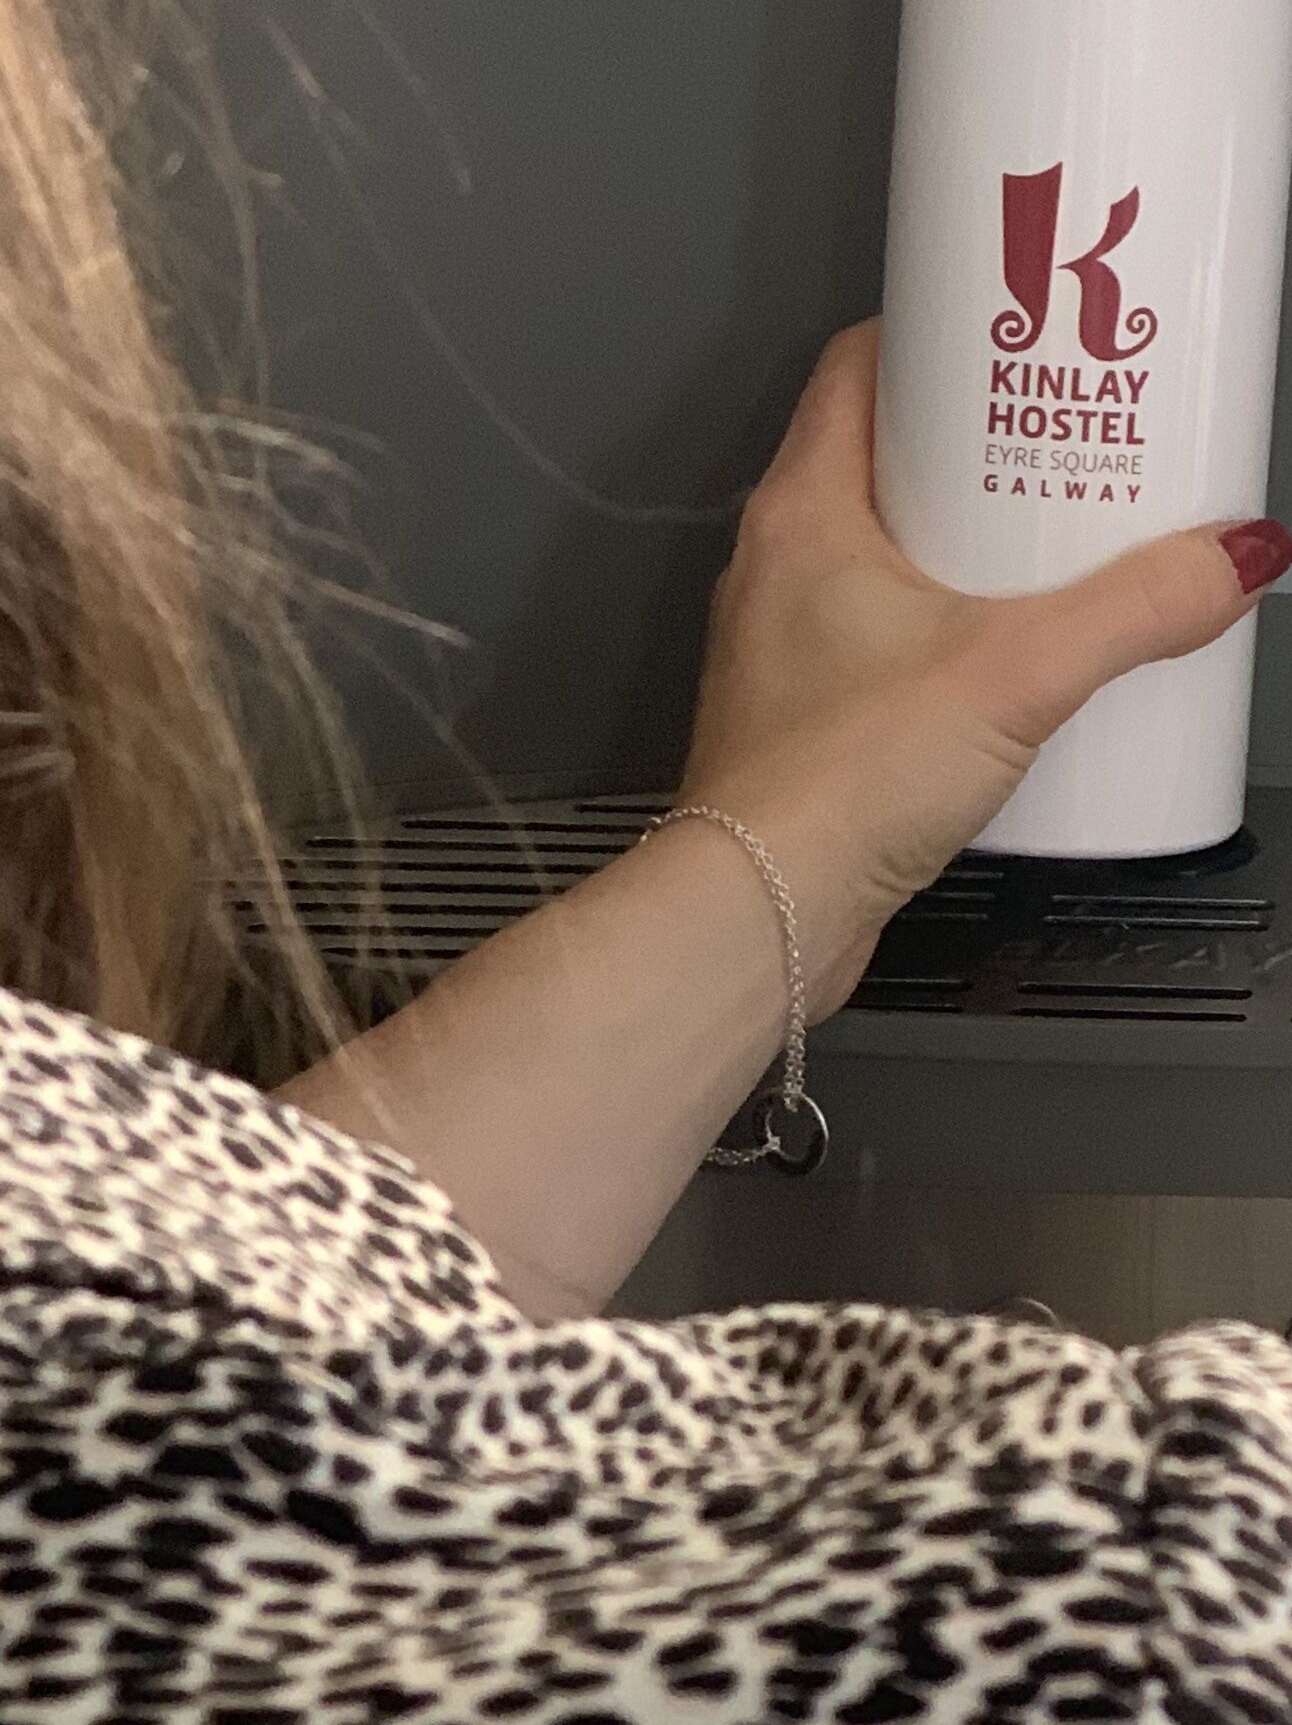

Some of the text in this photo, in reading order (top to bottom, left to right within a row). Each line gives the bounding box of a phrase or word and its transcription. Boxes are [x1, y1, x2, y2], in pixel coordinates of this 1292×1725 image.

[989, 359, 1150, 404] KINLAY
[986, 401, 1146, 445] HOSTEL
[984, 443, 1144, 476] EYRE SQUARE
[982, 474, 1142, 503] GALWAY
